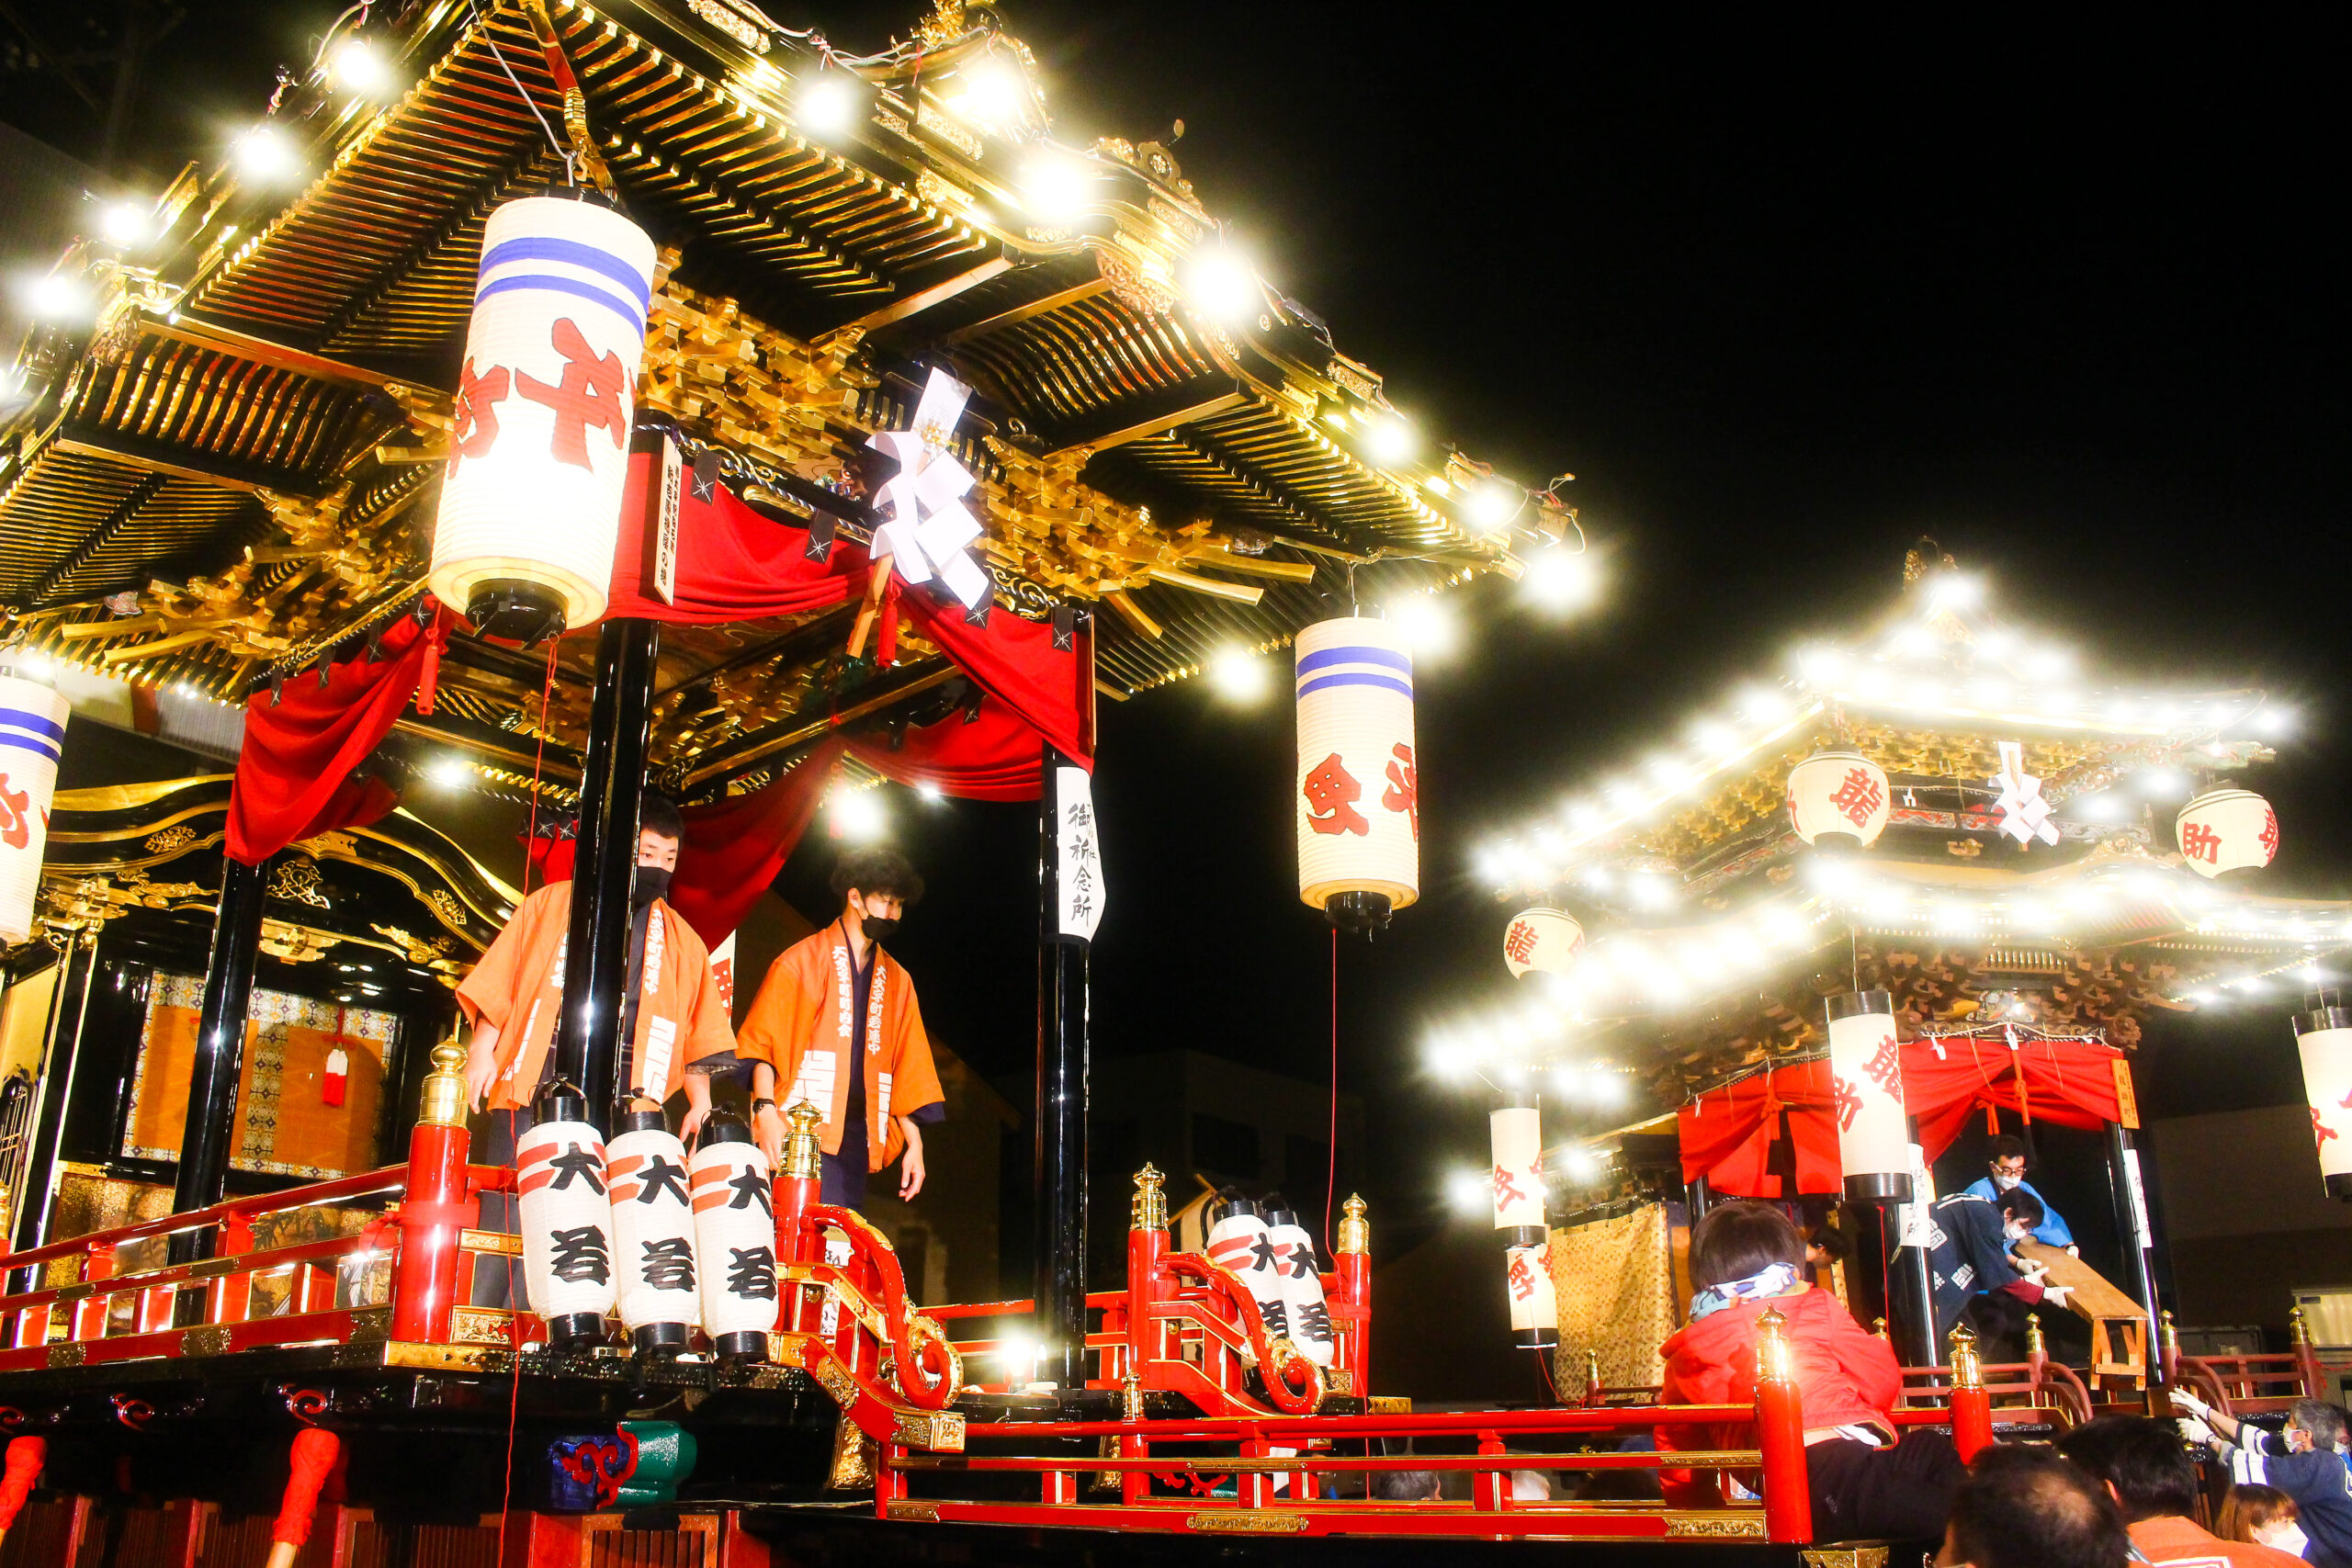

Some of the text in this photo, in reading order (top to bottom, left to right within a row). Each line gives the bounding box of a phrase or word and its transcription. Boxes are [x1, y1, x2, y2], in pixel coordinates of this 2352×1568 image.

[1068, 803, 1092, 927] 御祈念所
[2183, 821, 2222, 864] 助
[832, 945, 853, 1038] 大文字町町内会
[867, 964, 887, 1055] 大文字町若連中
